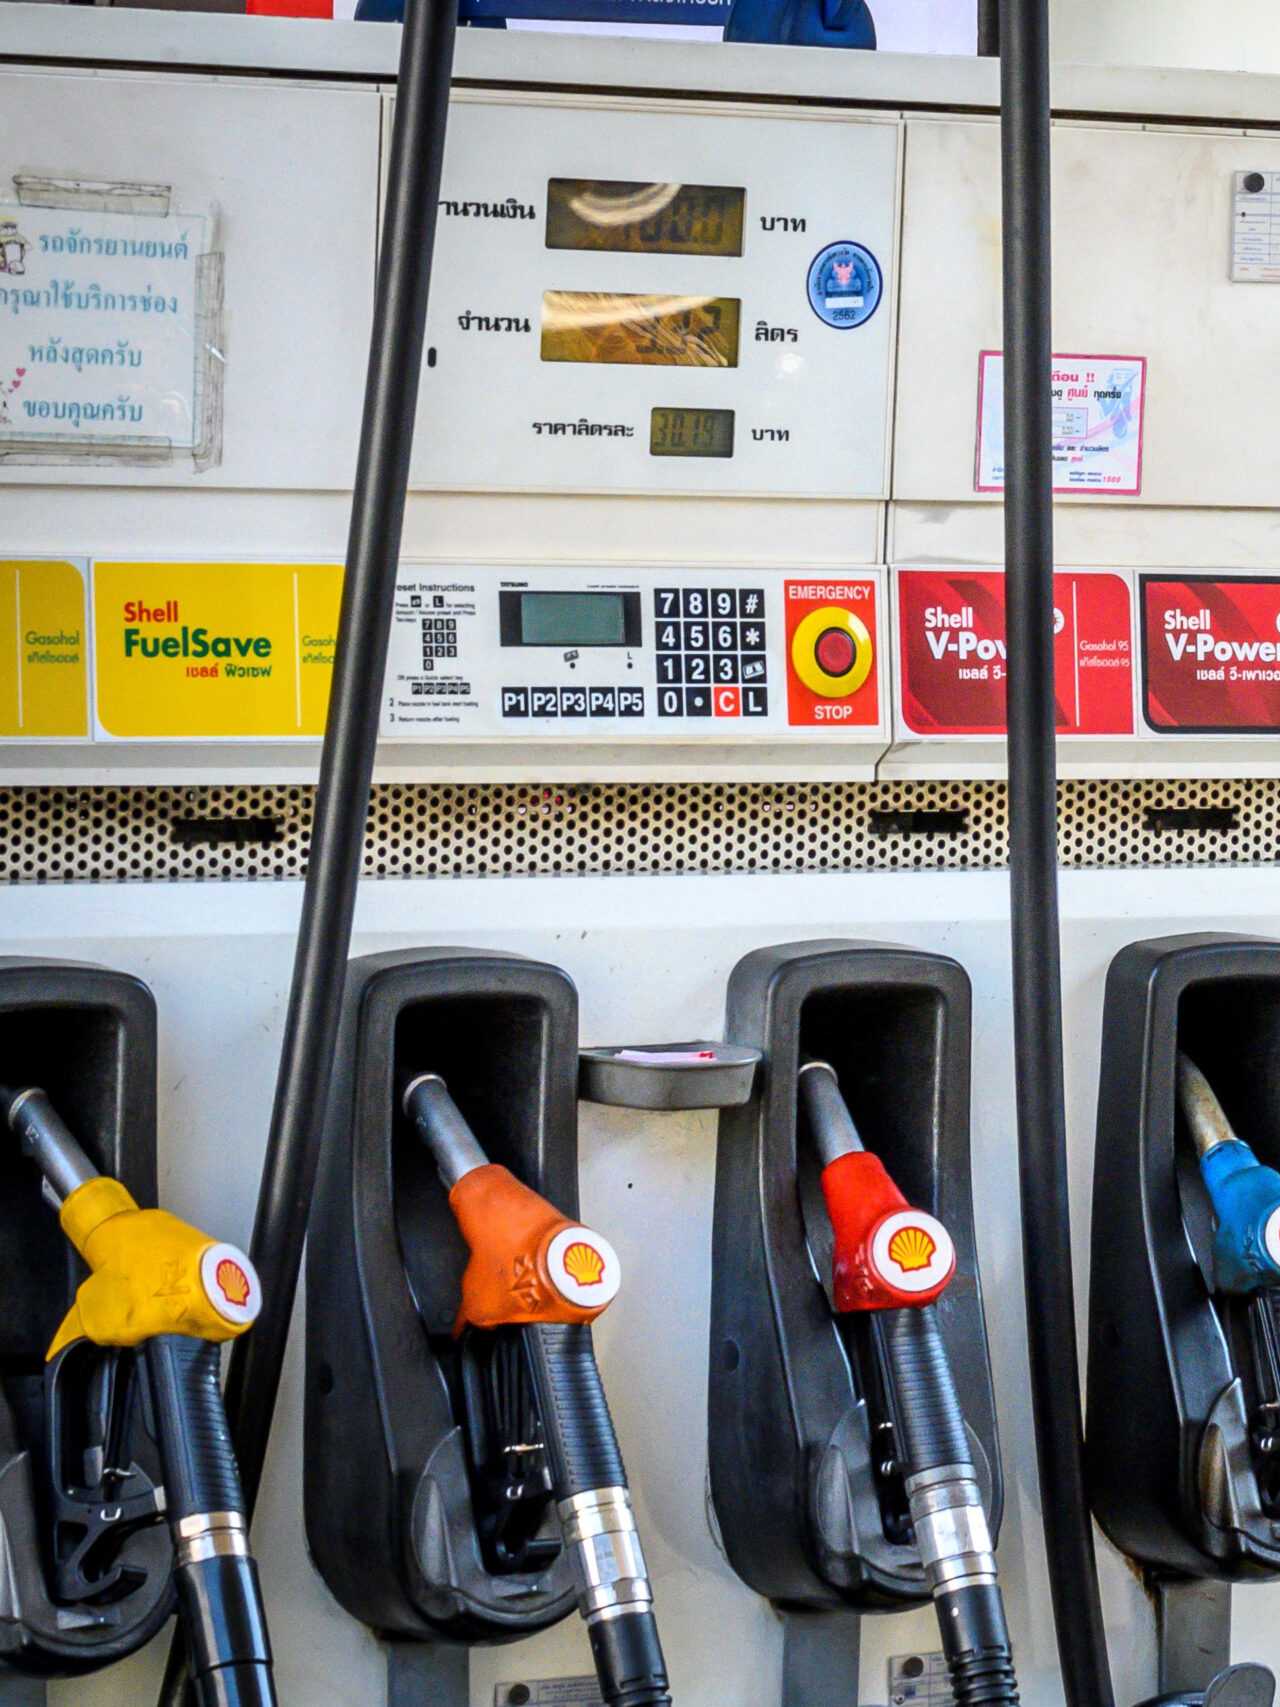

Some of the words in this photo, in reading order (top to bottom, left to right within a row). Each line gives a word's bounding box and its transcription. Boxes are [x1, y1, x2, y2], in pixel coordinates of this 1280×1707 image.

[760, 215, 807, 233] บาท
[39, 228, 188, 260] รถจักรยานยนต์
[458, 311, 531, 333] จำนวน
[755, 322, 799, 343] ลิตร
[28, 336, 142, 372] หลังสุดครับ
[23, 395, 143, 427] ขอบคุณครับ
[532, 418, 634, 438] ราคาลิตรละ
[751, 426, 790, 443] บาท
[396, 583, 416, 592] eset
[419, 583, 475, 593] Instructions
[788, 585, 871, 600] EMERGENCY
[124, 600, 178, 623] Shell
[660, 593, 674, 615] 7
[689, 593, 703, 615] 8
[717, 593, 731, 615] 9
[745, 593, 758, 614] #
[925, 607, 973, 629] Shell
[1164, 609, 1211, 631] Shell
[25, 631, 80, 646] Gasohol
[124, 626, 272, 658] FuelSave
[303, 635, 336, 647] Gasoh
[661, 626, 676, 648] 4
[690, 626, 704, 648] 5
[718, 627, 732, 648] 6
[1080, 639, 1115, 653] Gasohol
[1117, 640, 1129, 652] 95
[186, 662, 219, 678] เชลล์
[664, 659, 674, 680] 1
[691, 659, 705, 680] 2
[719, 659, 733, 680] 3
[958, 664, 988, 681] เชลล์
[1197, 664, 1225, 682] เชลล์
[504, 693, 525, 711] P1
[533, 693, 557, 711] P2
[562, 693, 586, 711] P3
[591, 693, 614, 711] P4
[619, 693, 642, 711] P5
[664, 691, 677, 713] 0
[719, 691, 735, 712] C
[749, 691, 762, 712] L
[814, 705, 853, 720] STOP
